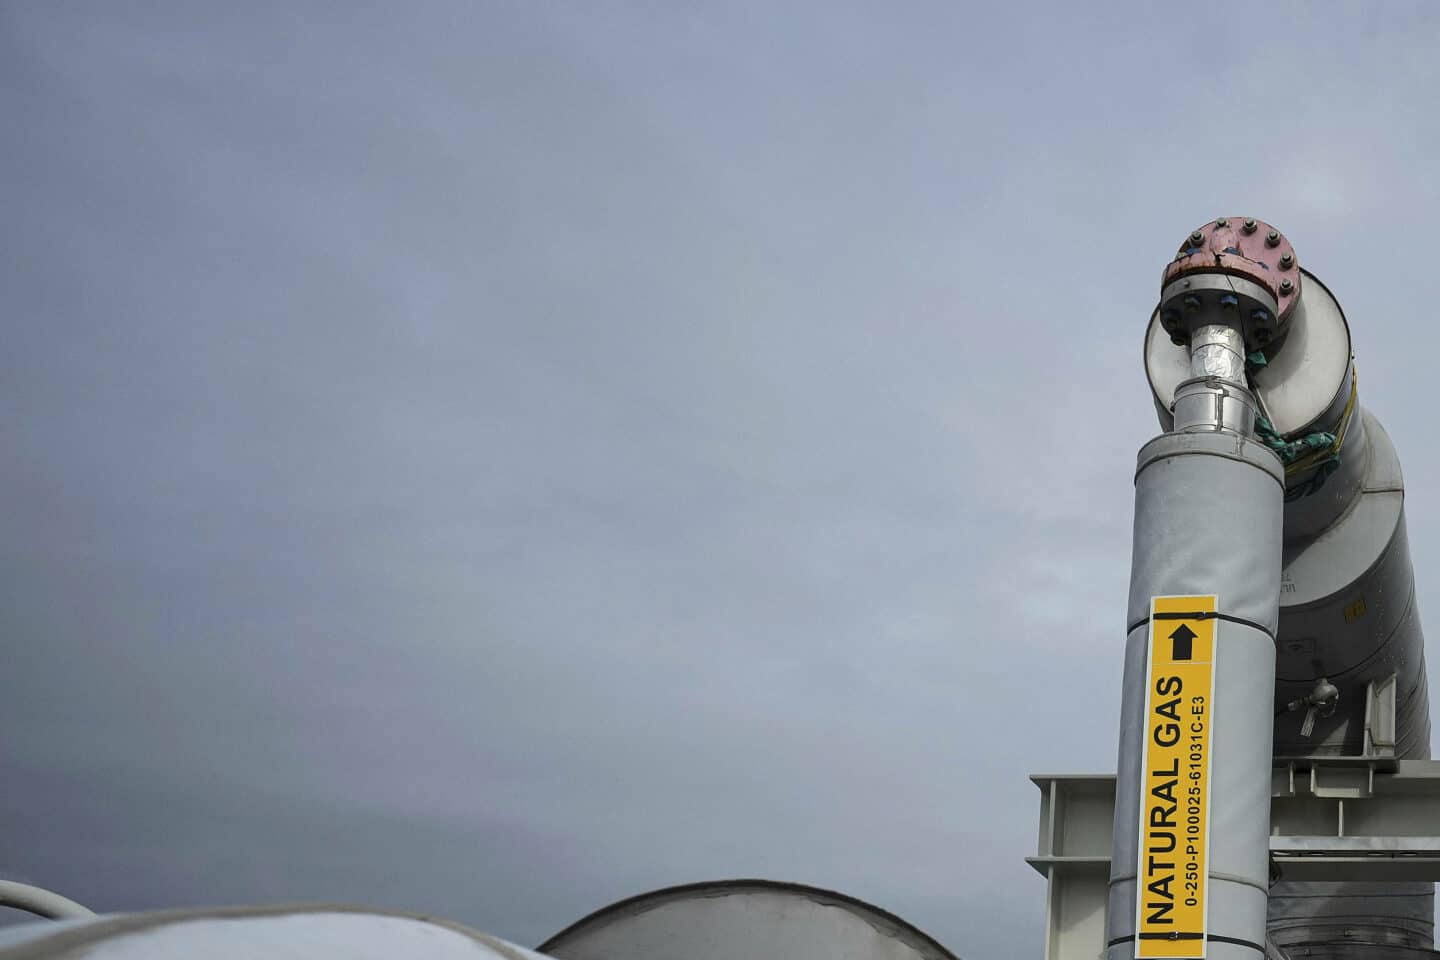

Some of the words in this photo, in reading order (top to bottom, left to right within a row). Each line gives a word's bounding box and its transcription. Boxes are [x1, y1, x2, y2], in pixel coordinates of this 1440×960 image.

[1154, 676, 1183, 748] GAS
[1146, 758, 1179, 924] NATURAL
[1185, 696, 1205, 906] 0-250-P100025-61031C-E3
